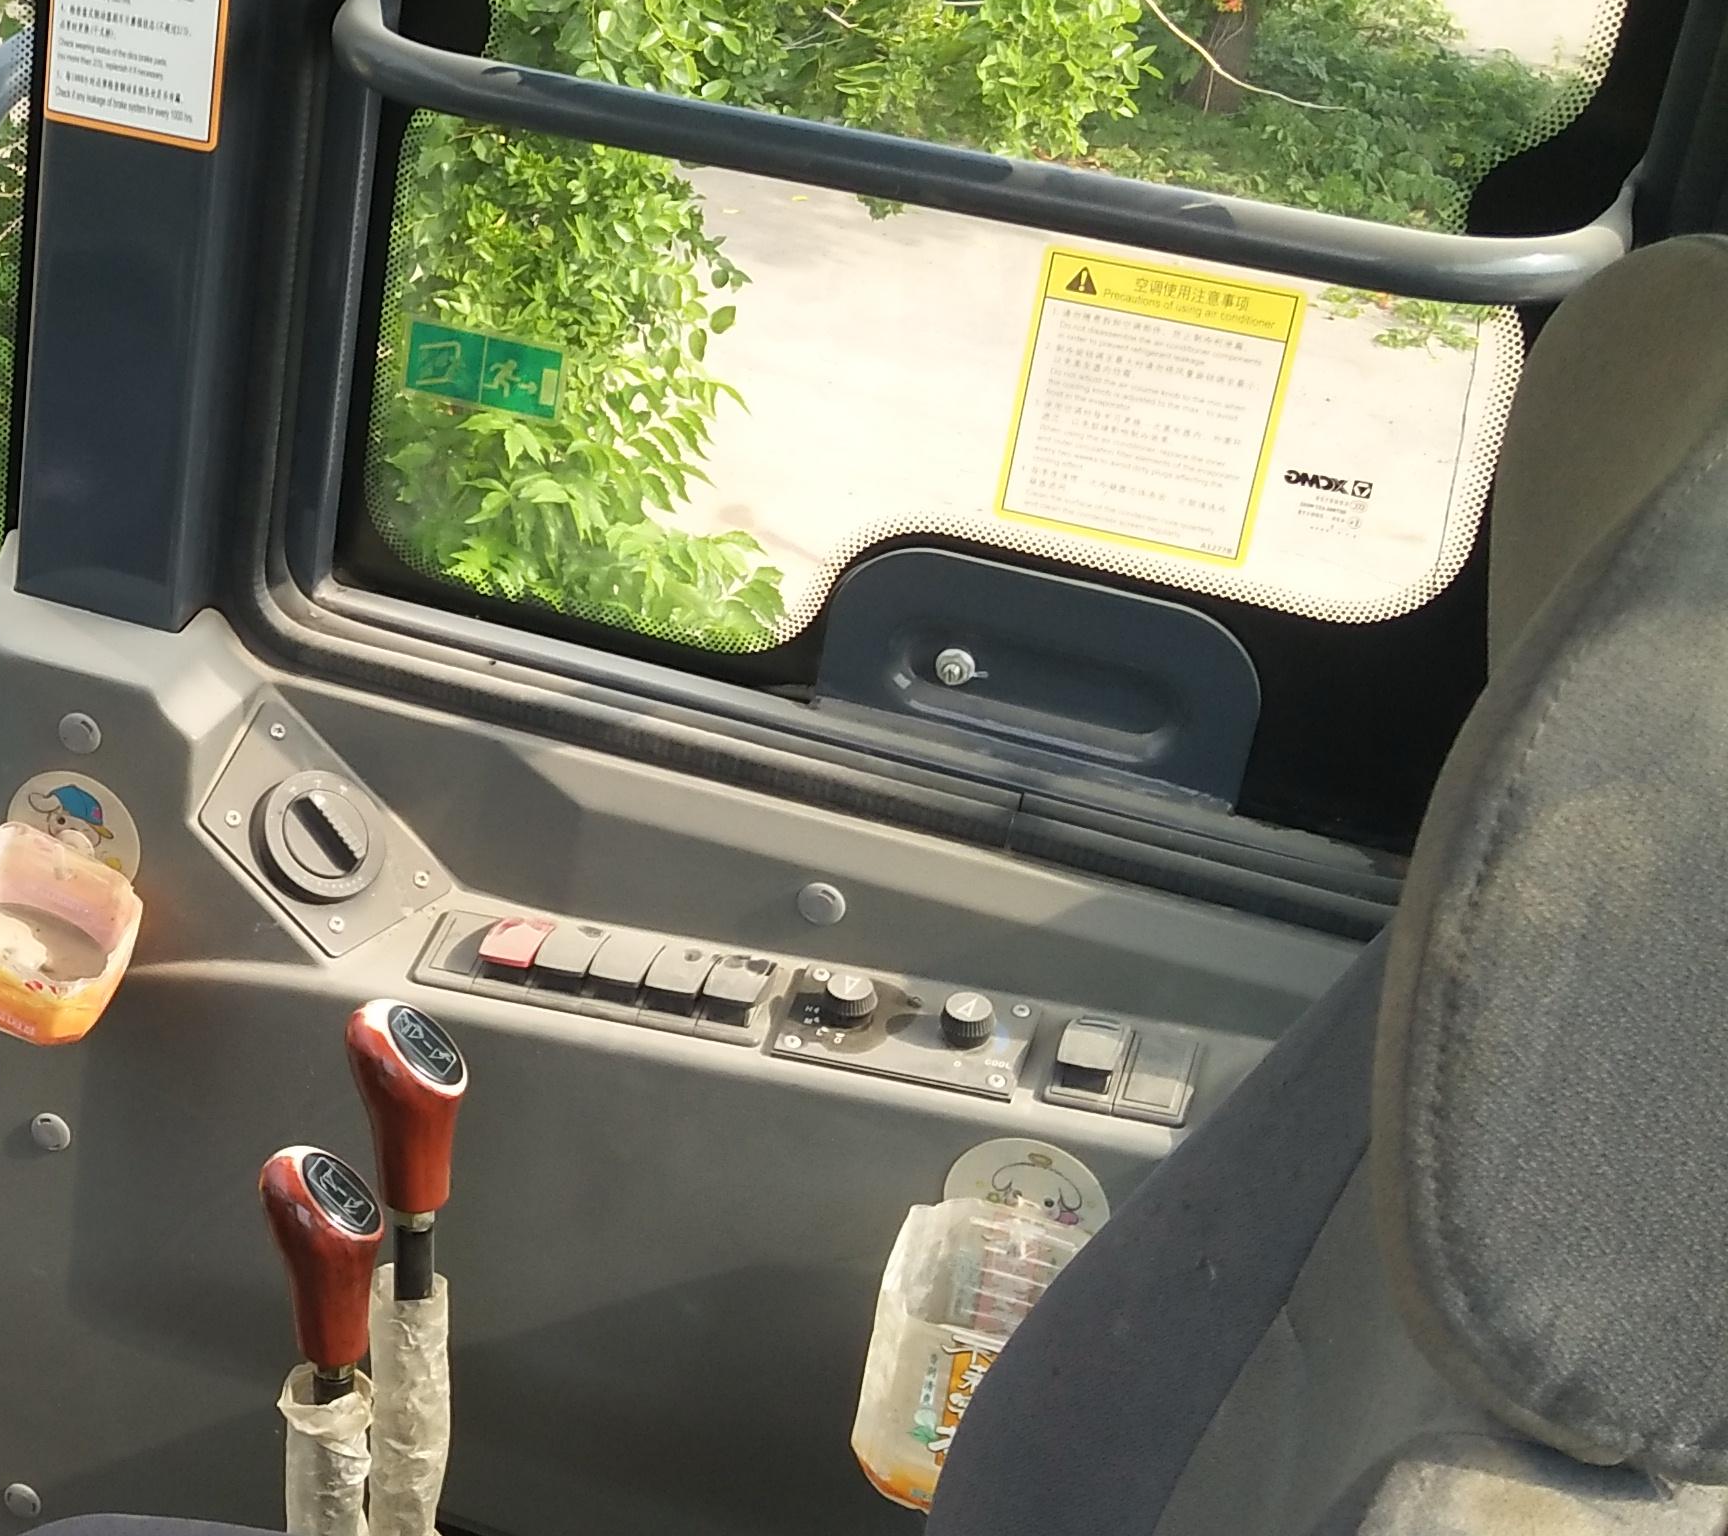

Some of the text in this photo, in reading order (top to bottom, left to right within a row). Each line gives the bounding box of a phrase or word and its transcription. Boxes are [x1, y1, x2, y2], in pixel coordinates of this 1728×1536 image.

[1102, 287, 1161, 308] Precautions
[1162, 298, 1174, 310] of
[1133, 276, 1251, 312] 空调使用注意事项
